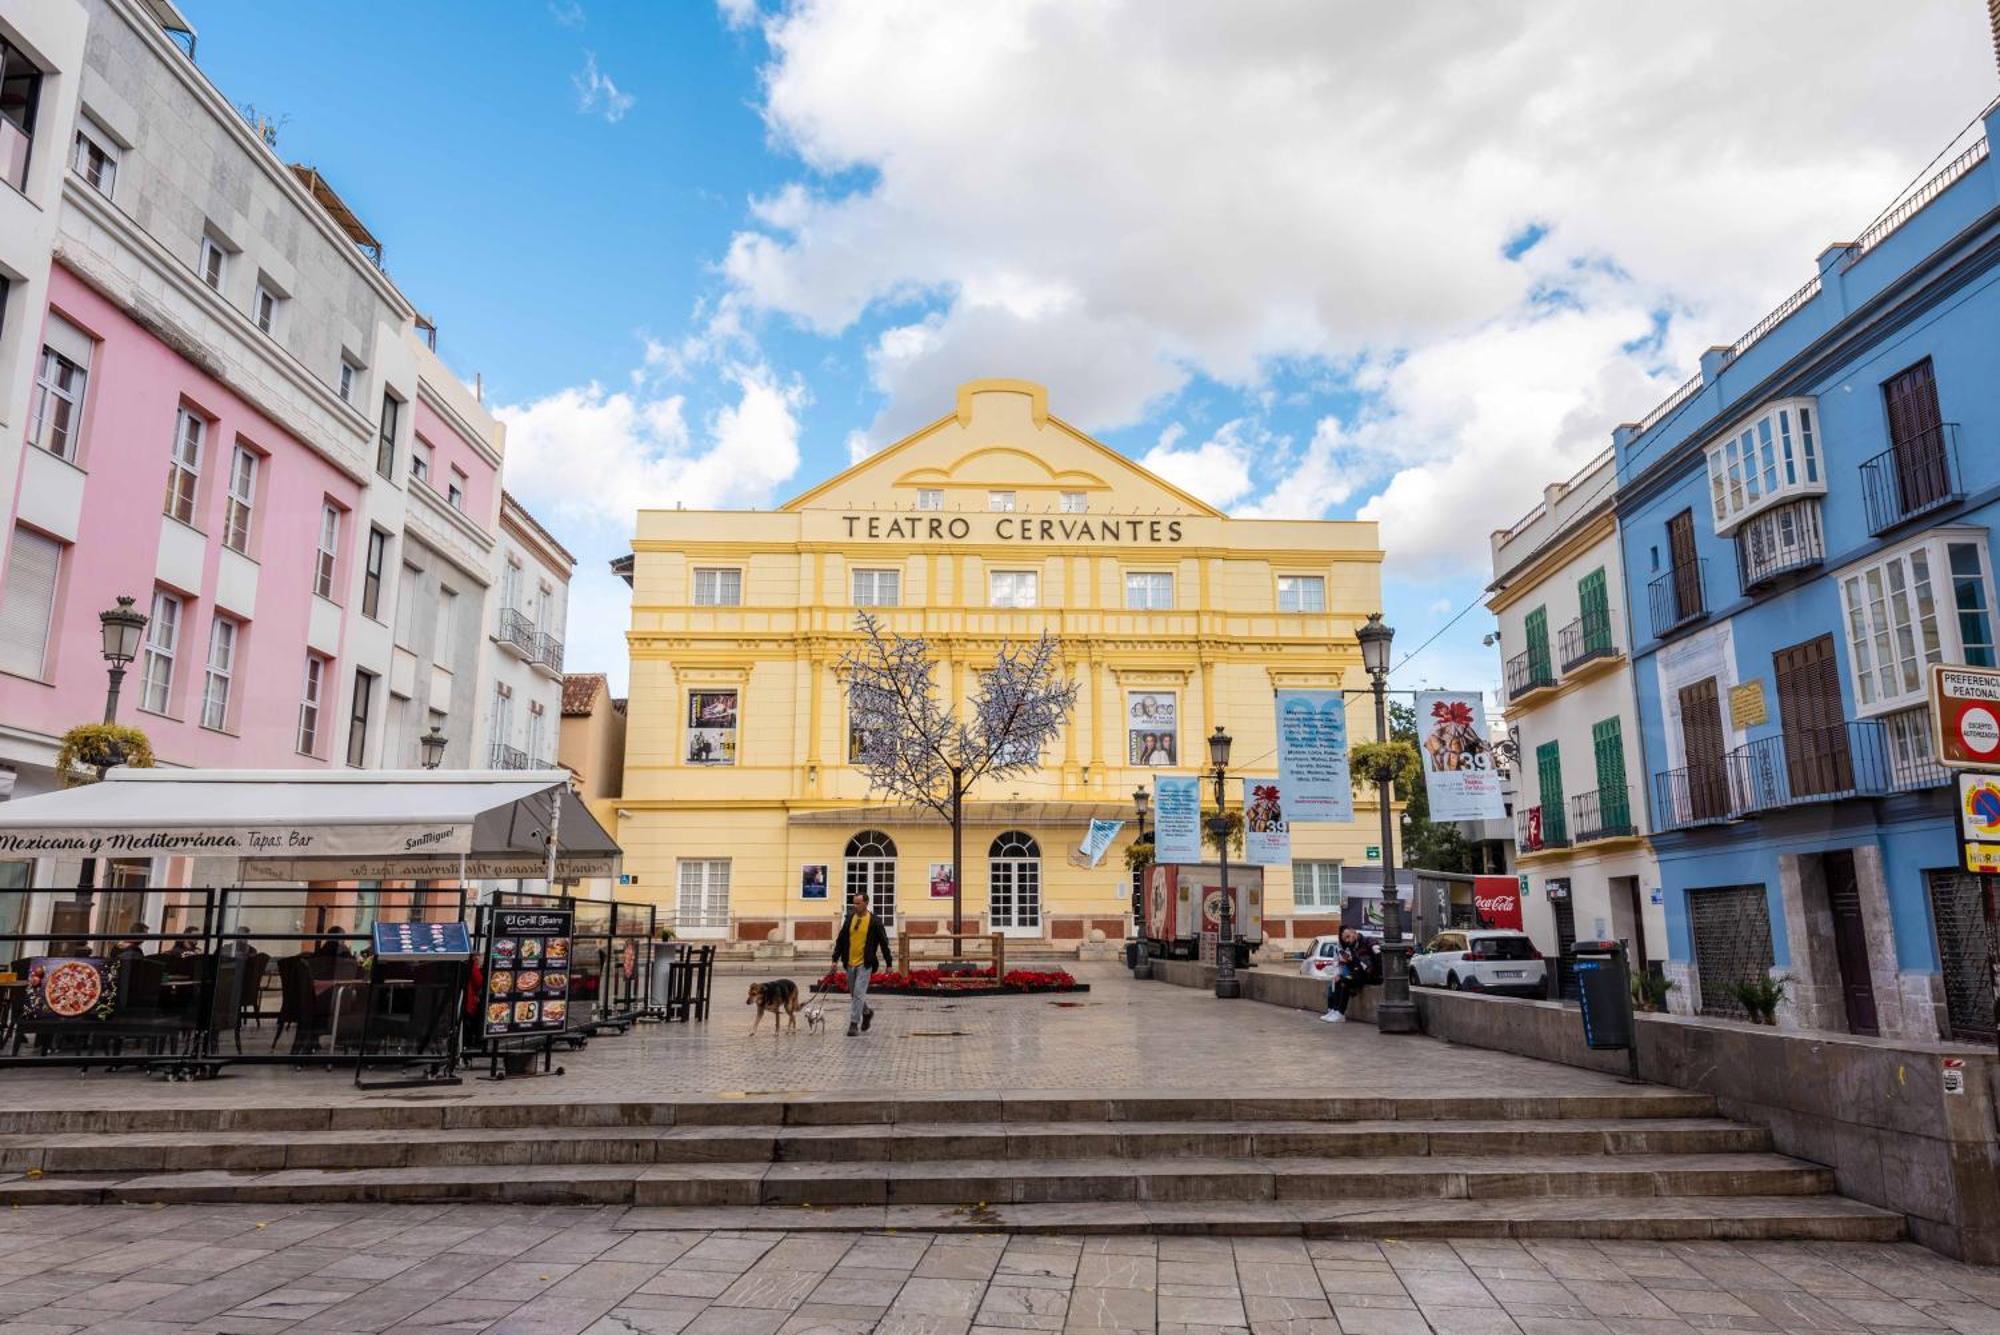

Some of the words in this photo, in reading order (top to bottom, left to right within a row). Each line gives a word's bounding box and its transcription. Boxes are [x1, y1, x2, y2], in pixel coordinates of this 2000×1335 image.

[842, 516, 970, 540] TEATRO
[996, 518, 1183, 542] CERVANTES
[1953, 686, 1999, 699] PEATONAL
[1459, 752, 1492, 772] 39
[0, 834, 87, 851] Mexicana
[90, 838, 102, 853] y
[107, 833, 242, 851] Mediterránea.
[288, 829, 313, 847] Bar
